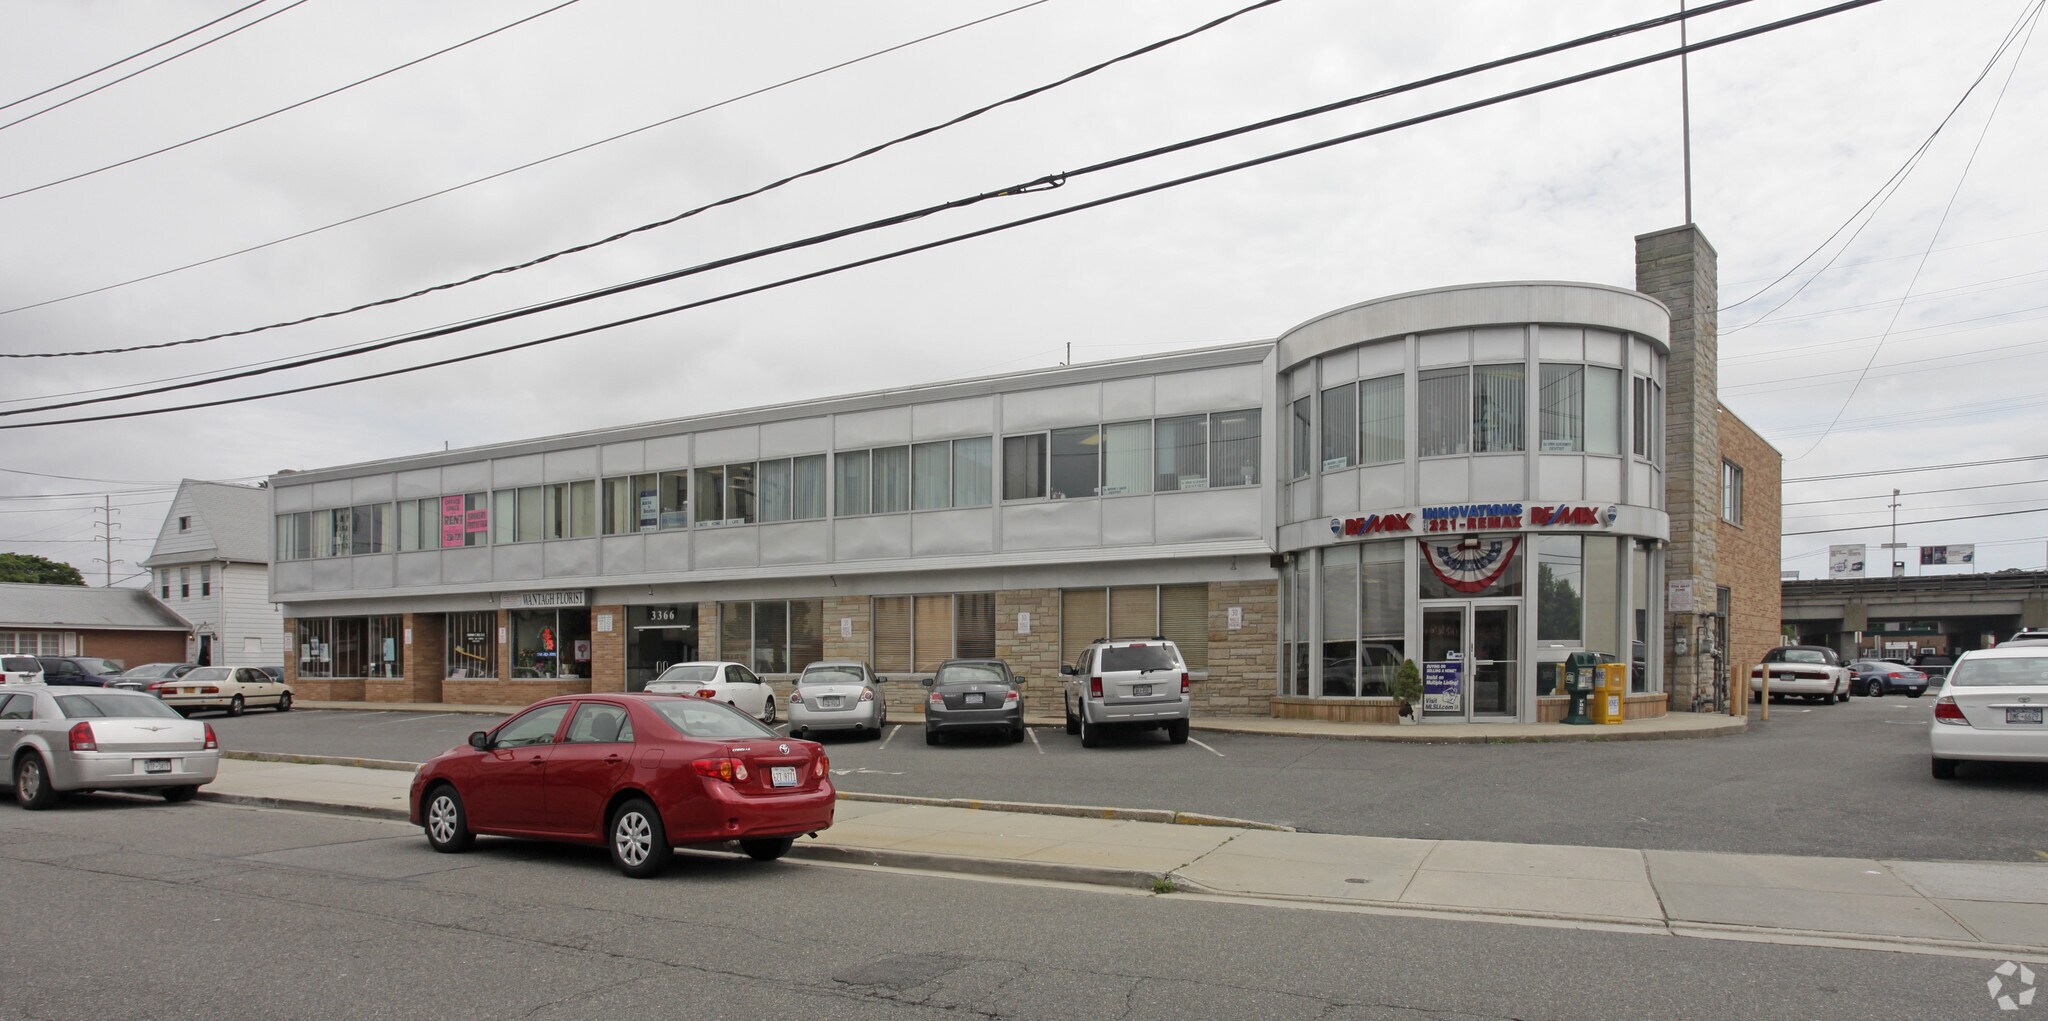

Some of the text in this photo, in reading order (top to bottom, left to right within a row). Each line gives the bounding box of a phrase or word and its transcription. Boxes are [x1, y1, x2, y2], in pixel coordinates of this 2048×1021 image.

[1422, 503, 1523, 520] INNOVATIONS
[1531, 504, 1599, 525] RE/MAX
[443, 514, 463, 526] RENT
[1345, 513, 1413, 536] RE/MAX
[522, 592, 555, 606] WANTAGH
[556, 591, 583, 605] FLORIST
[651, 610, 675, 620] 3366
